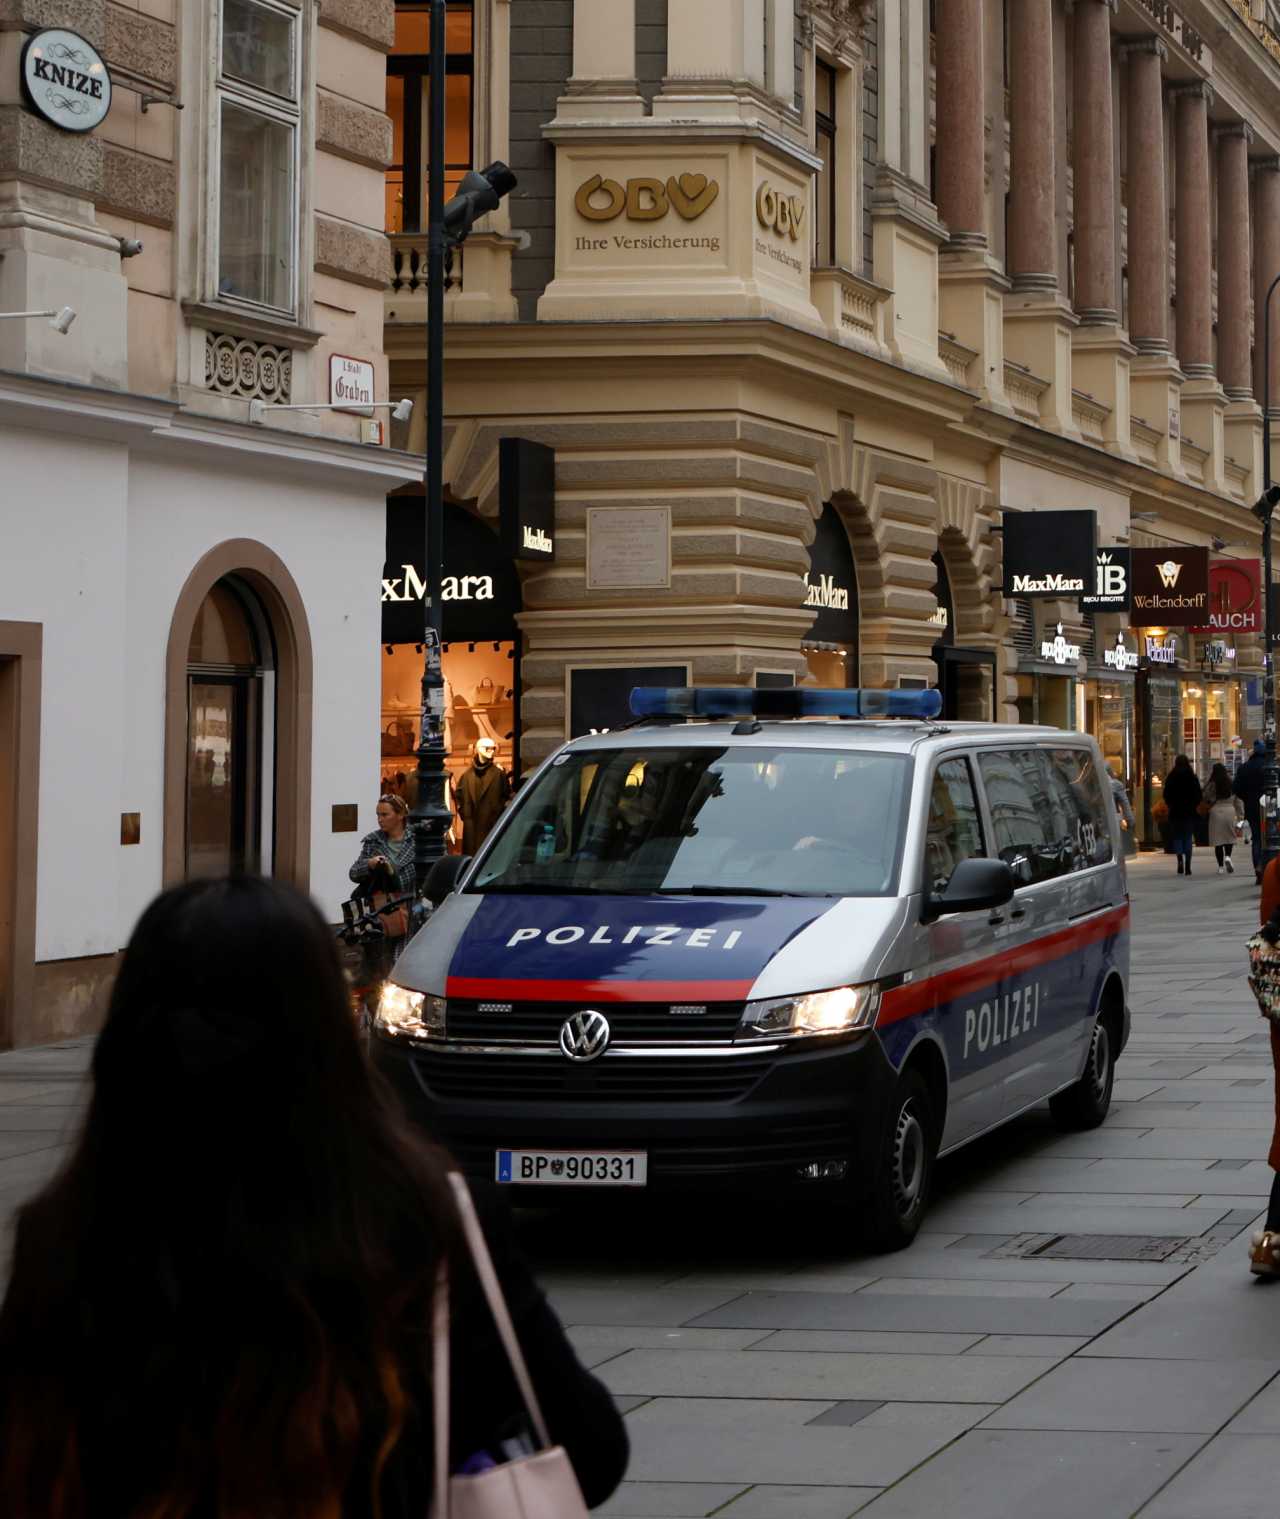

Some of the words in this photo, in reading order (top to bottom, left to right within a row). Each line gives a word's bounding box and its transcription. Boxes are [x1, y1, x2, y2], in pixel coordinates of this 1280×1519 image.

[33, 56, 102, 99] KNIZE
[575, 236, 608, 250] Ihre
[613, 235, 720, 251] Versicherung
[335, 376, 369, 403] Graben
[1012, 574, 1084, 592] MaxMara
[1134, 593, 1206, 609] Wellendorff
[1194, 613, 1255, 628] AUCH
[505, 926, 742, 949] POLIZEI
[963, 982, 1040, 1059] POLIZEI
[566, 1157, 635, 1180] 90331
